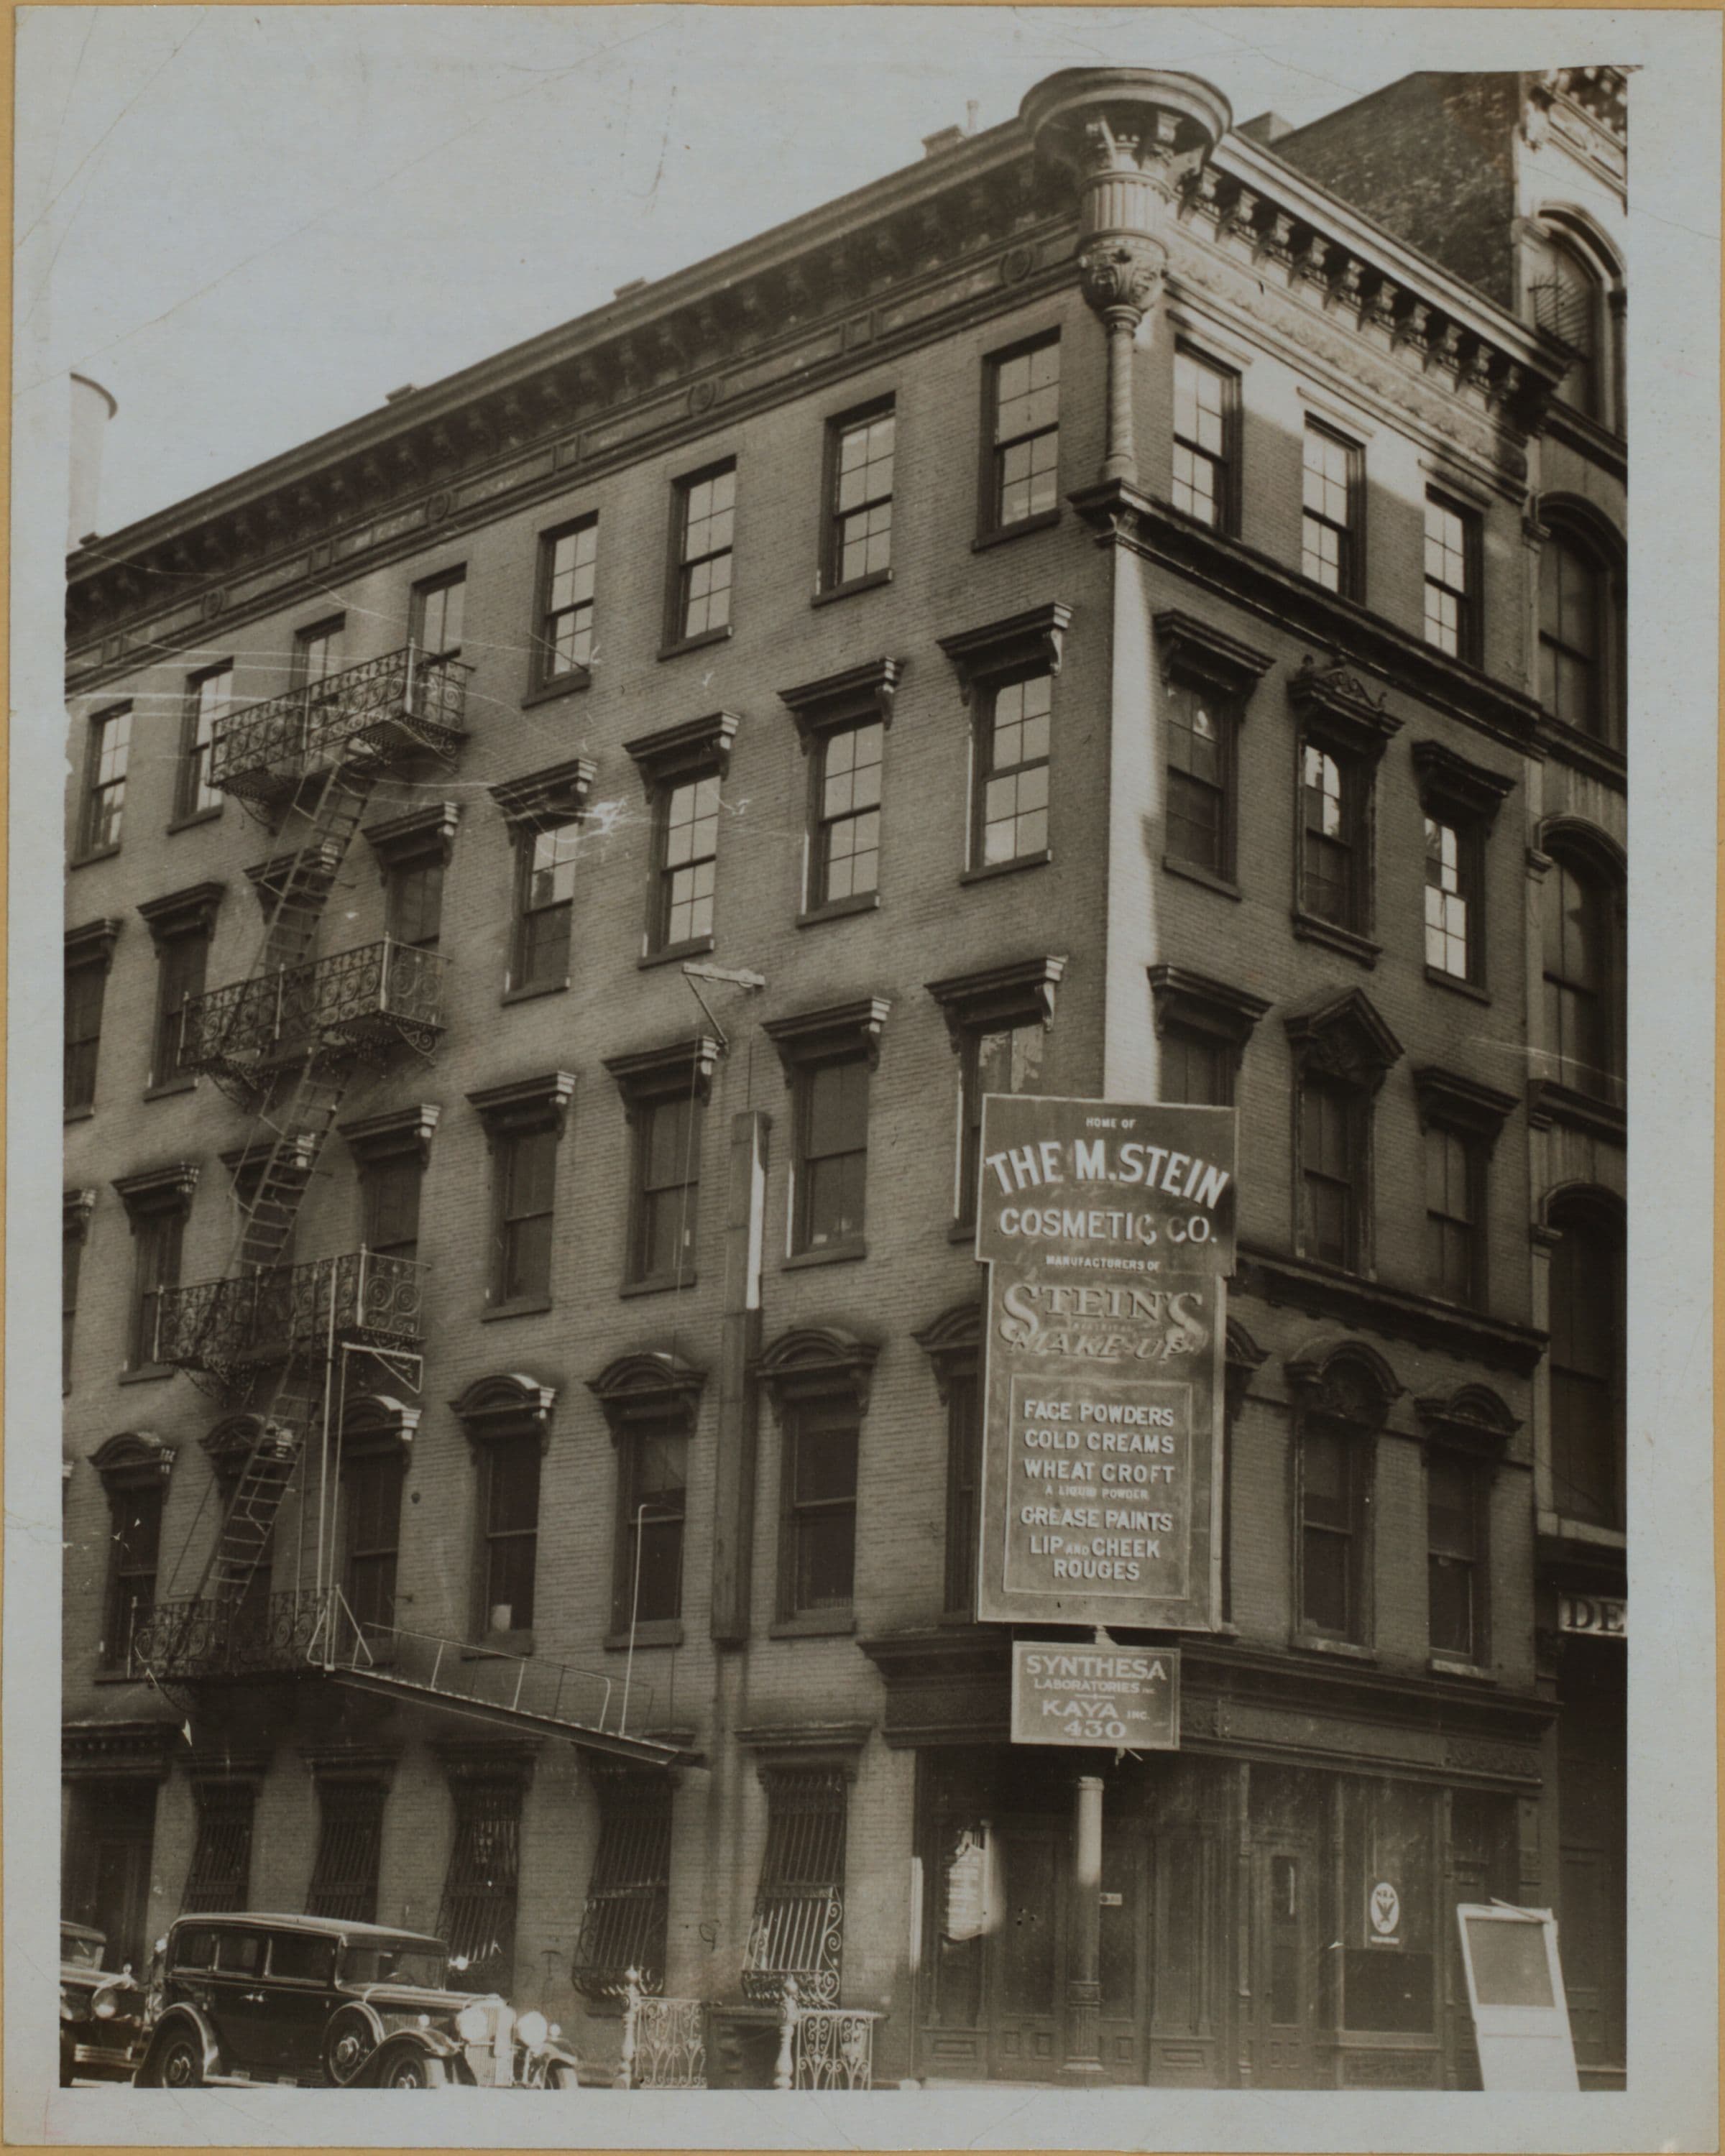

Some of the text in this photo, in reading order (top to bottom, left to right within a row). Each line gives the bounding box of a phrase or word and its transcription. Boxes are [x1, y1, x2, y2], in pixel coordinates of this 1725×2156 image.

[1086, 1118, 1136, 1129] HOME OF
[985, 1141, 1064, 1196] THE
[1000, 1207, 1218, 1245] COSMETIC CO.
[1046, 1255, 1161, 1272] MANUFACTURERS OF
[1024, 1400, 1174, 1427] FACE POWDERS
[1024, 1429, 1175, 1455] COLD CREAMS
[1024, 1459, 1175, 1484] WHEAT CROFT
[1045, 1485, 1149, 1500] A LIQUID POWDER
[1021, 1506, 1174, 1532] GREASE PAINTS
[1031, 1535, 1161, 1558] LIP AND CHEEK
[1054, 1559, 1140, 1580] ROUGES
[1026, 1655, 1167, 1681] SYNTHESA
[1034, 1677, 1140, 1694] LABORATORIES
[1042, 1700, 1118, 1719] KAYA
[1064, 1720, 1126, 1739] 430
